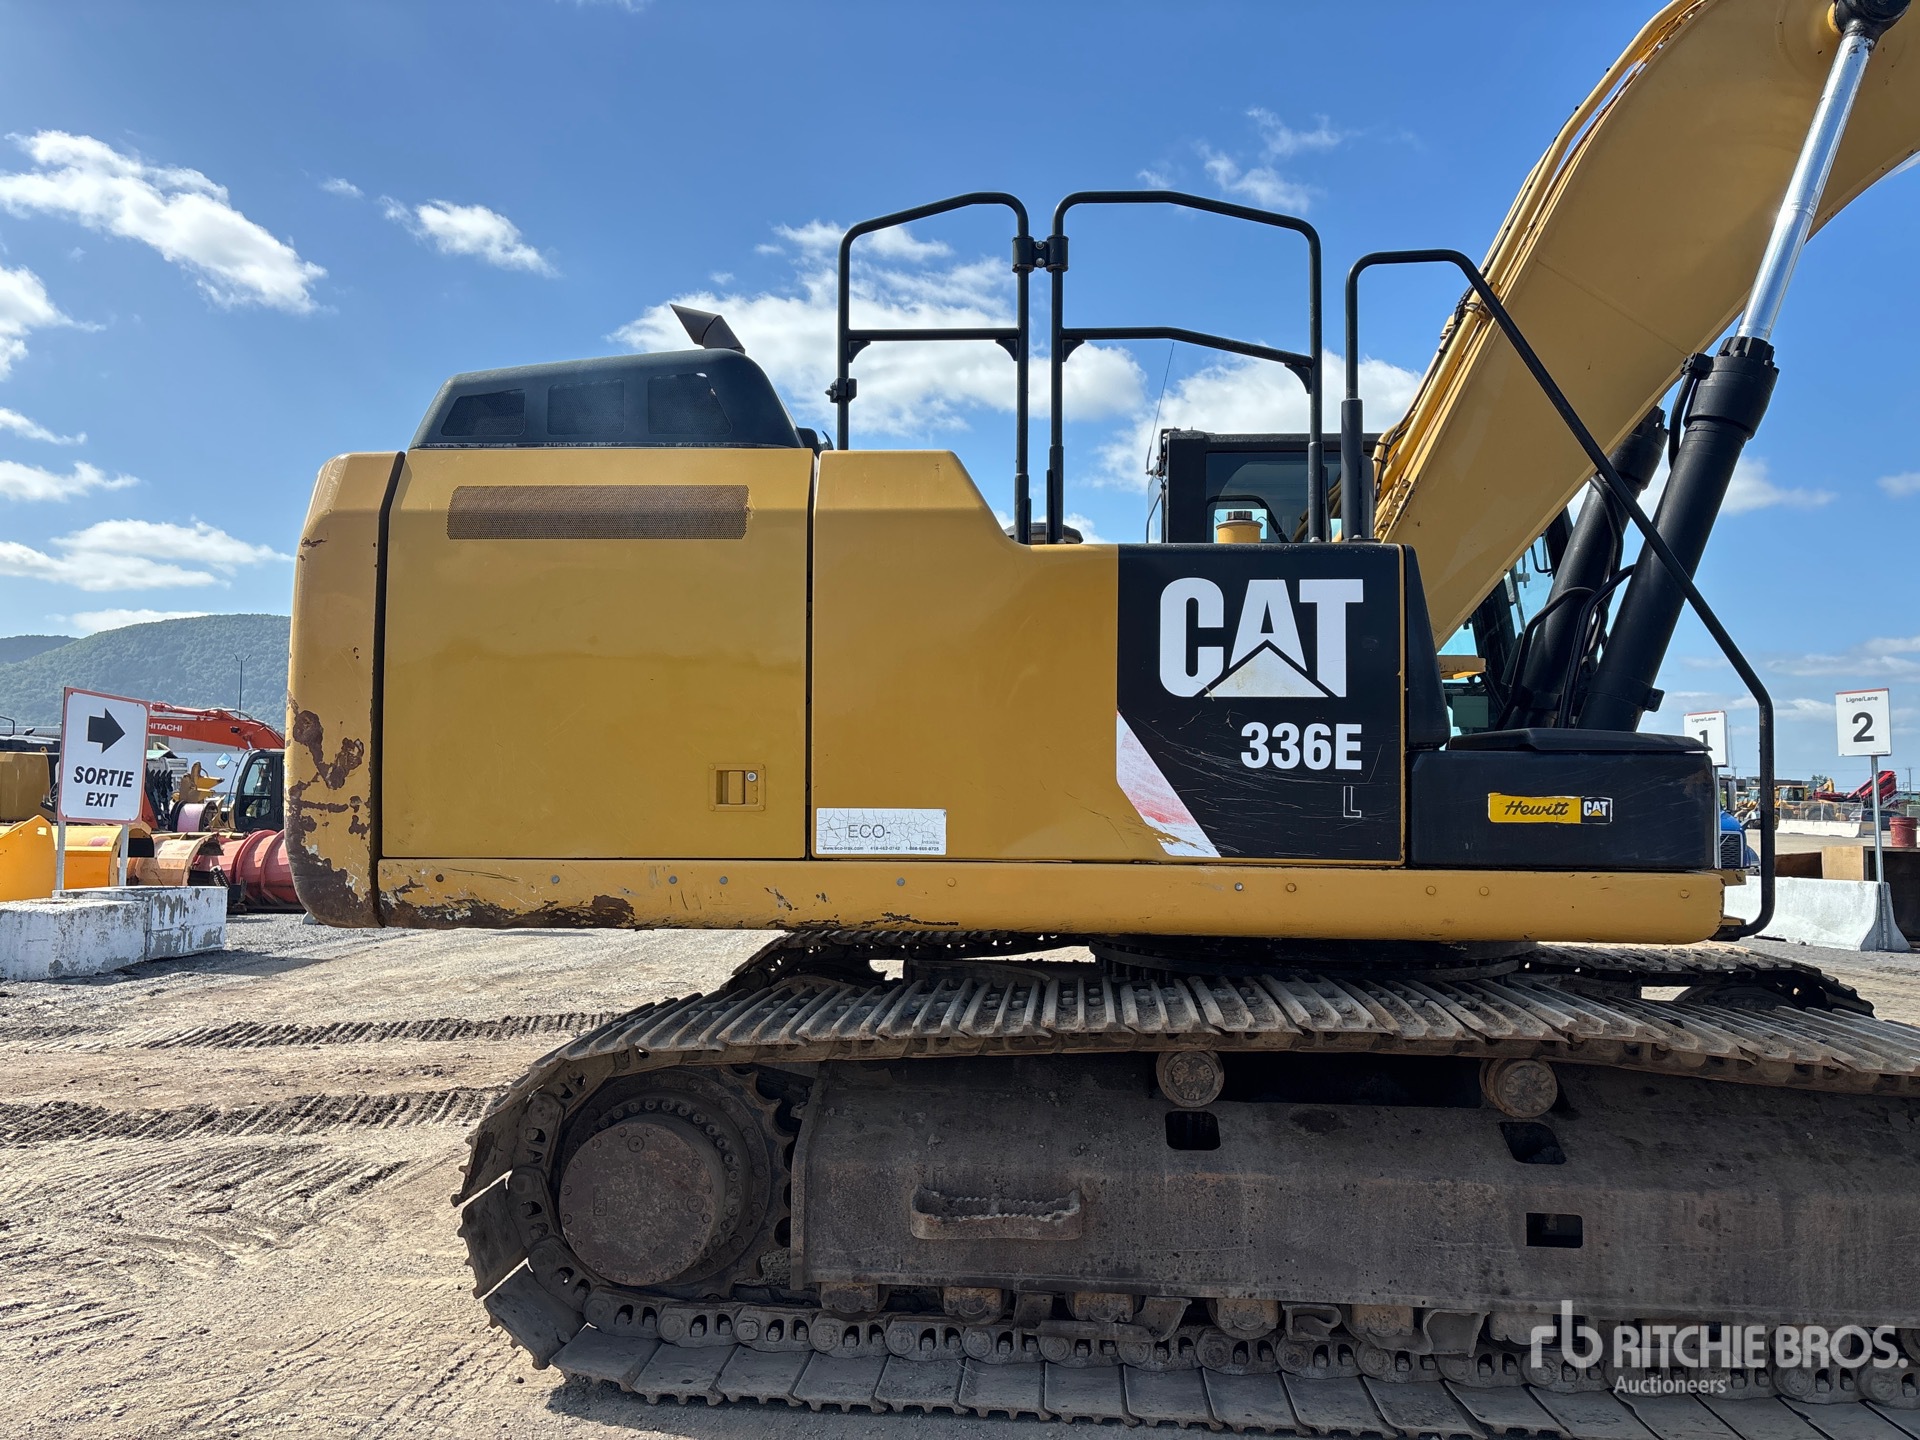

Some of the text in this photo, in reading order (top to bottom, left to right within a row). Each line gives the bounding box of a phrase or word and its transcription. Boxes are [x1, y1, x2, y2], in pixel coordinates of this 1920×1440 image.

[1159, 577, 1364, 698] CAT
[1845, 695, 1878, 703] Ligne/Lane
[1699, 729, 1709, 748] 1
[1852, 711, 1875, 743] 2
[1240, 721, 1362, 771] 336E
[73, 765, 135, 788] SORTIE
[85, 791, 119, 808] EXIT
[1343, 785, 1362, 818] L
[1504, 800, 1608, 817] Hewitt CAT
